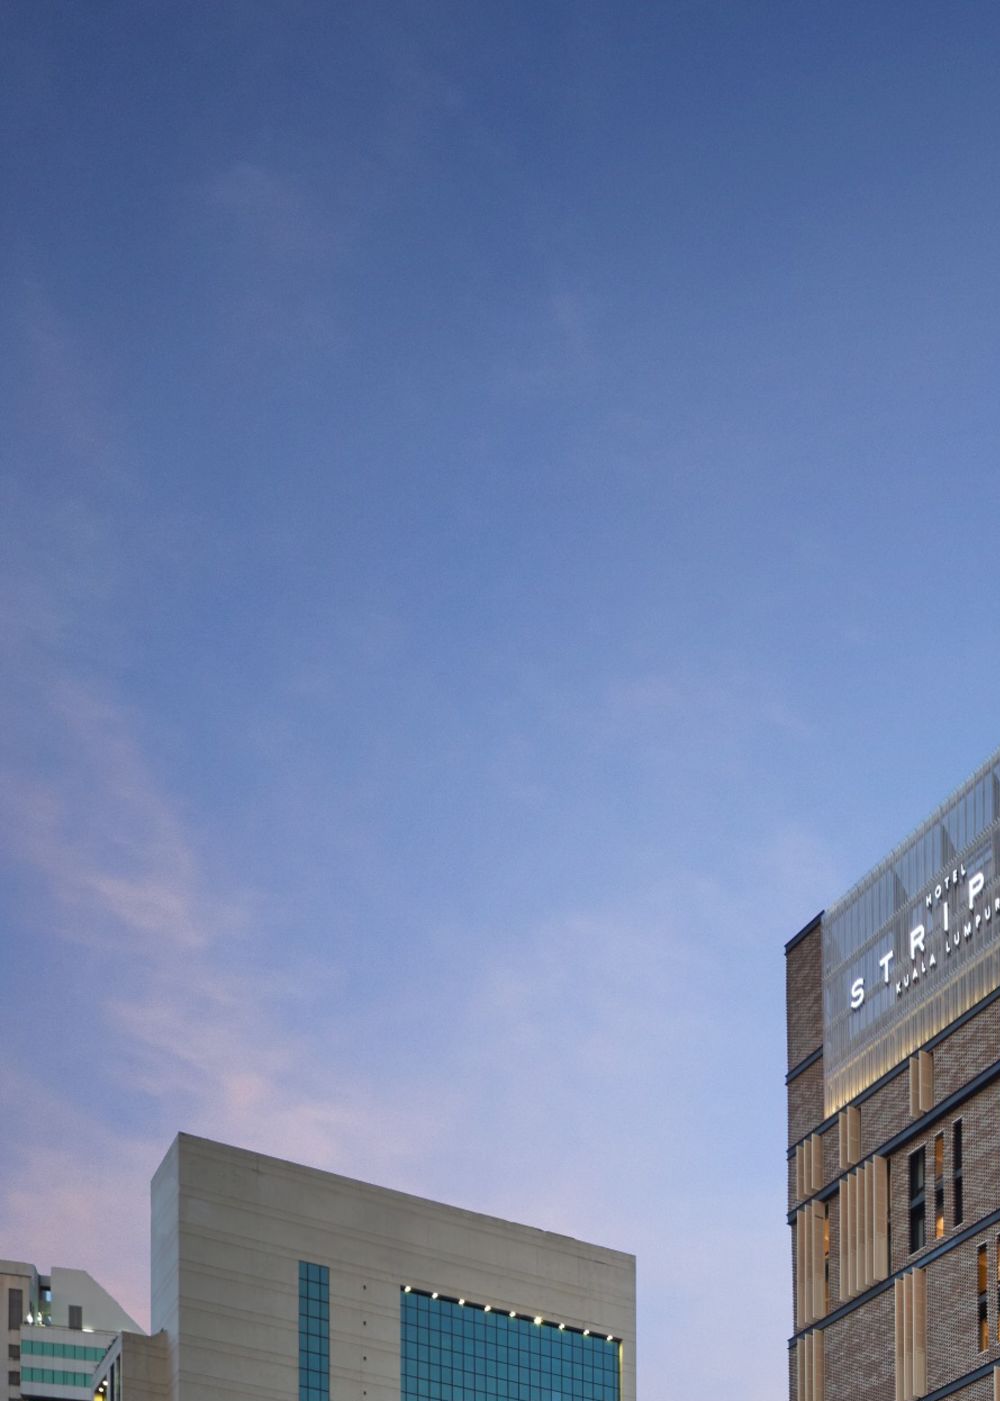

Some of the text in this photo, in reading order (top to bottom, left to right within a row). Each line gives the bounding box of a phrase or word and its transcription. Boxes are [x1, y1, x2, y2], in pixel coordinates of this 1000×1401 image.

[925, 864, 966, 907] HOTEL
[896, 898, 1000, 994] KUALA LUMPUR
